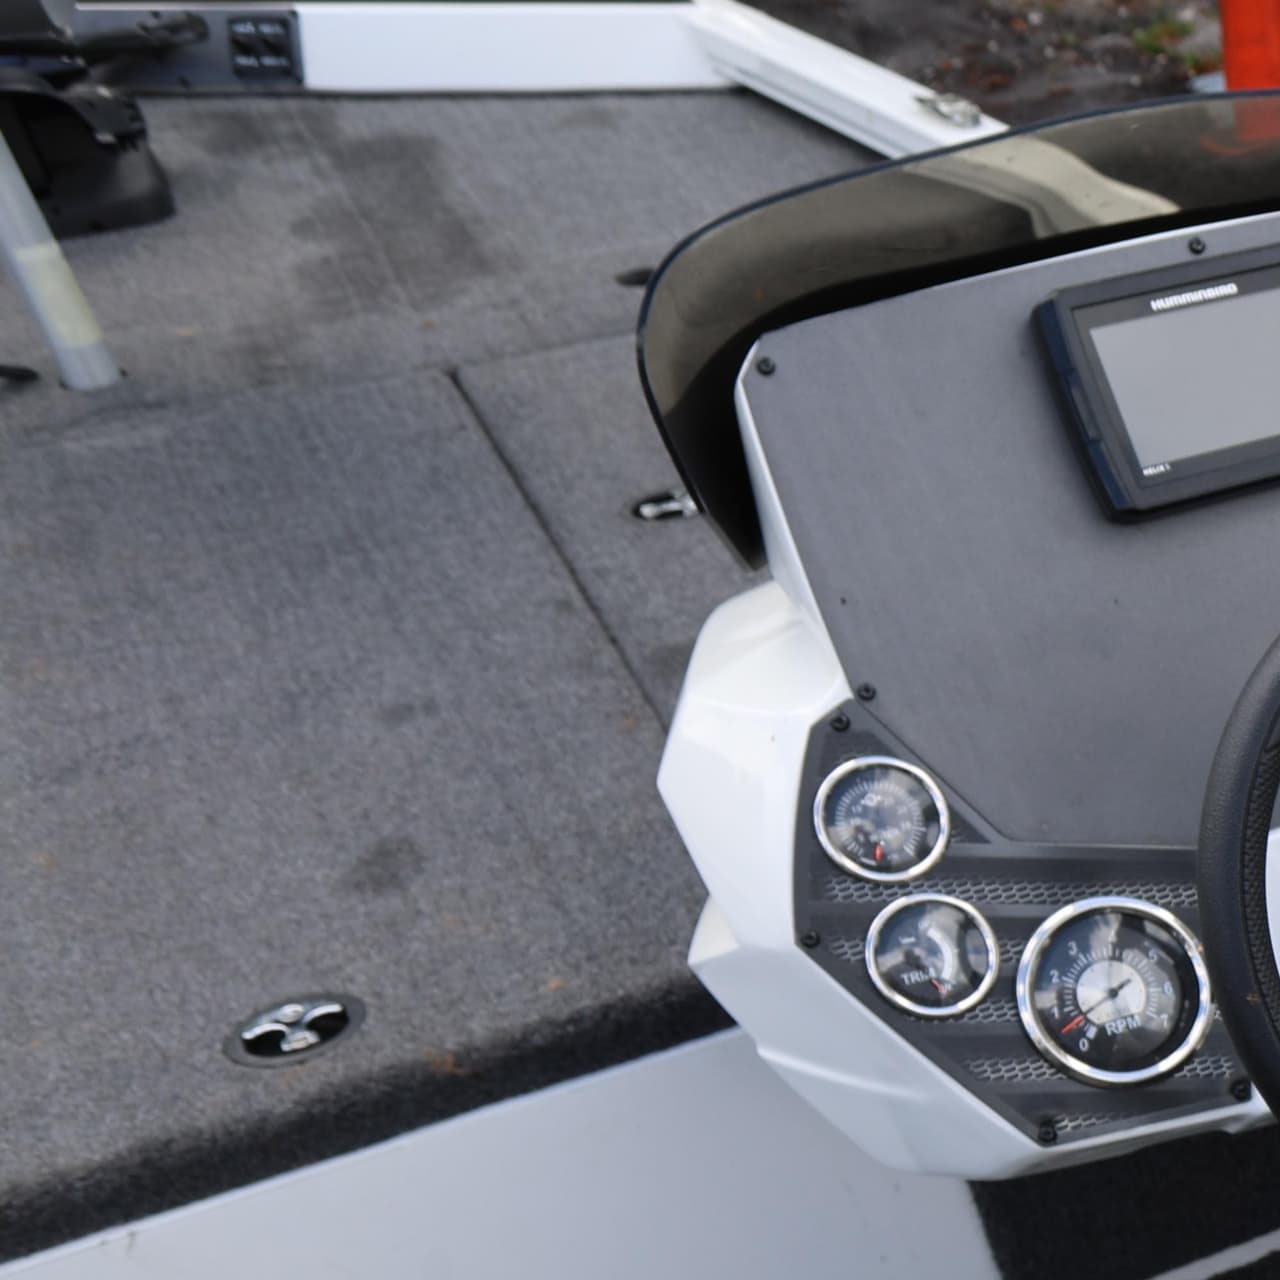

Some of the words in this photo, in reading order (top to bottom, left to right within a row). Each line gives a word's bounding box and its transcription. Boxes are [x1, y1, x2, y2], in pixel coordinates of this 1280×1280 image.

[1067, 941, 1078, 955] 3
[1050, 969, 1060, 983] 2
[1105, 1015, 1142, 1037] RPM
[1078, 1038, 1089, 1051] 0
